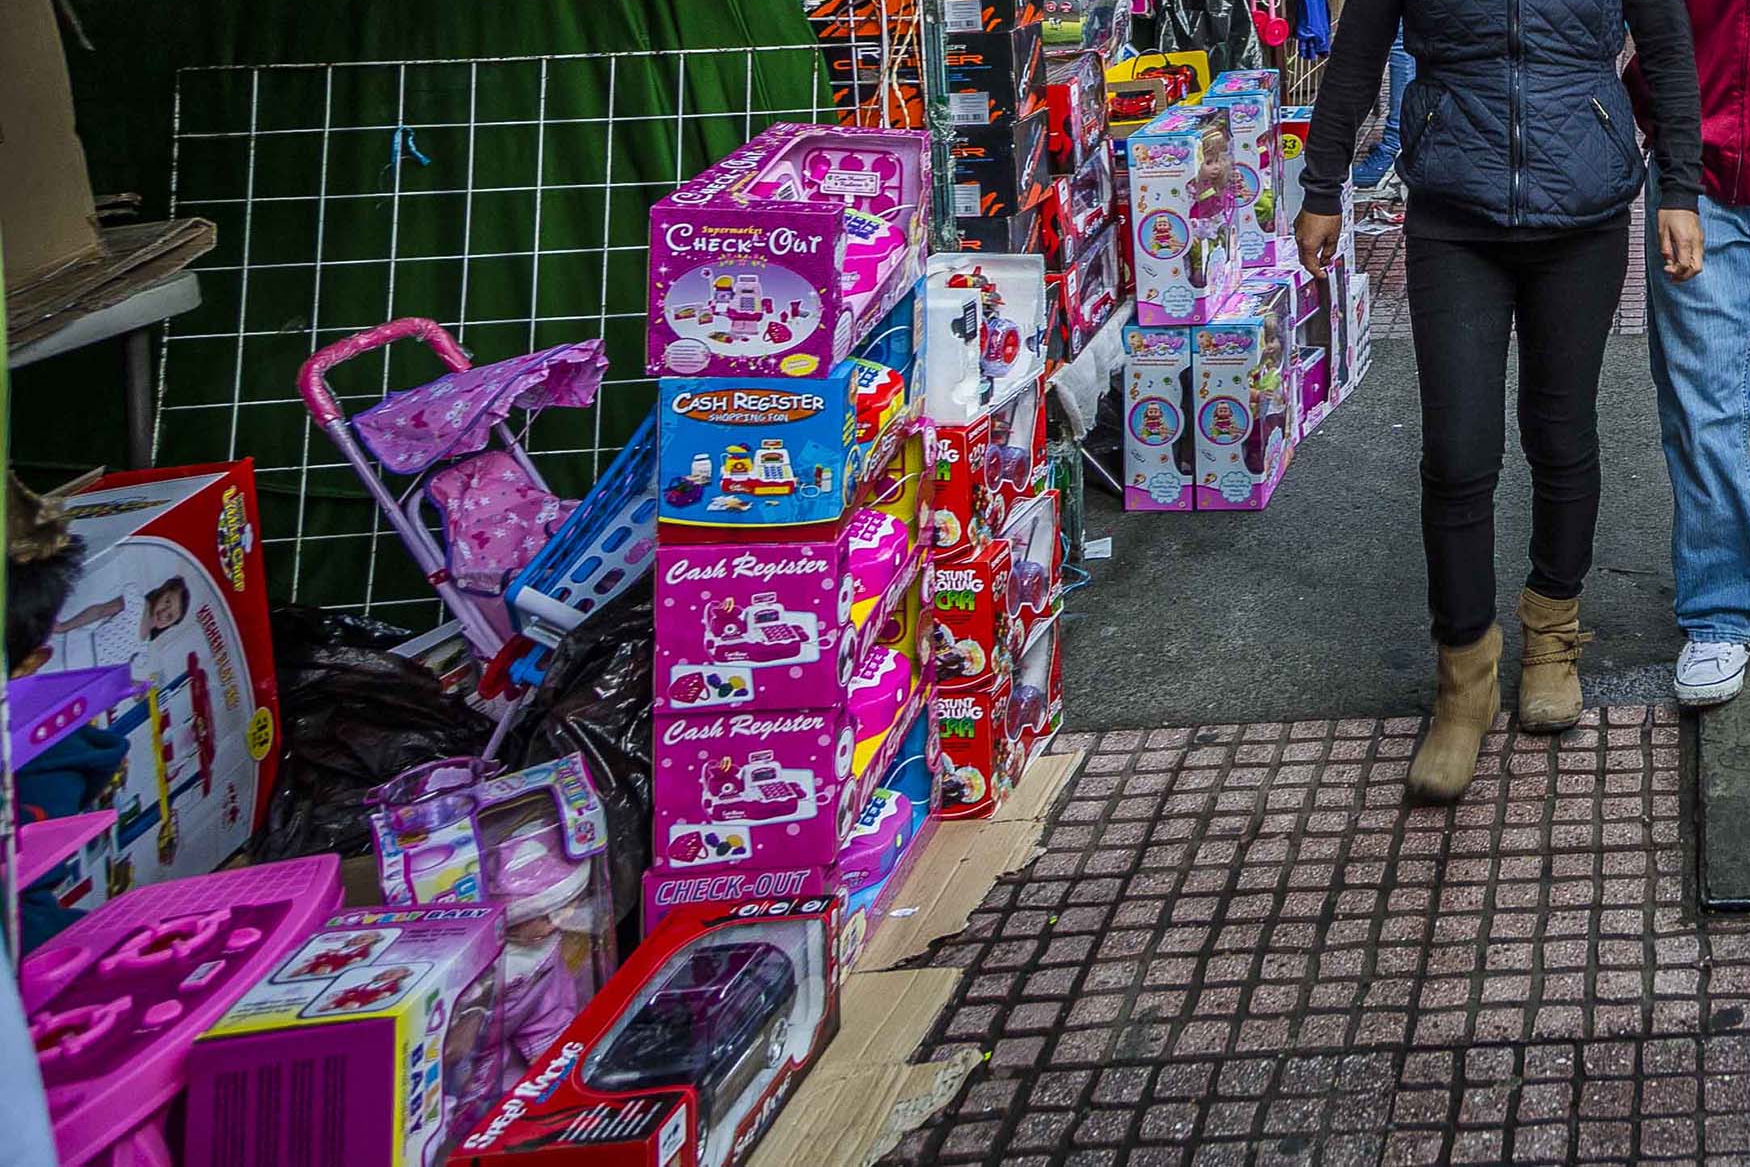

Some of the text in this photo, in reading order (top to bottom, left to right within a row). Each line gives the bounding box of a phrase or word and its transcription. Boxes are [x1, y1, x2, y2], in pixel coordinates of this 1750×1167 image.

[671, 391, 825, 413] CASH REGISTER
[666, 551, 828, 585] Cash Register
[935, 569, 977, 581] STUNT
[932, 579, 984, 592] OLLING
[937, 697, 977, 709] STUNT
[936, 706, 984, 719] OLLING
[662, 710, 825, 746] Cash Register
[655, 868, 811, 906] CHECK-OUT
[423, 907, 493, 921] BABY
[409, 1042, 424, 1134] BABY
